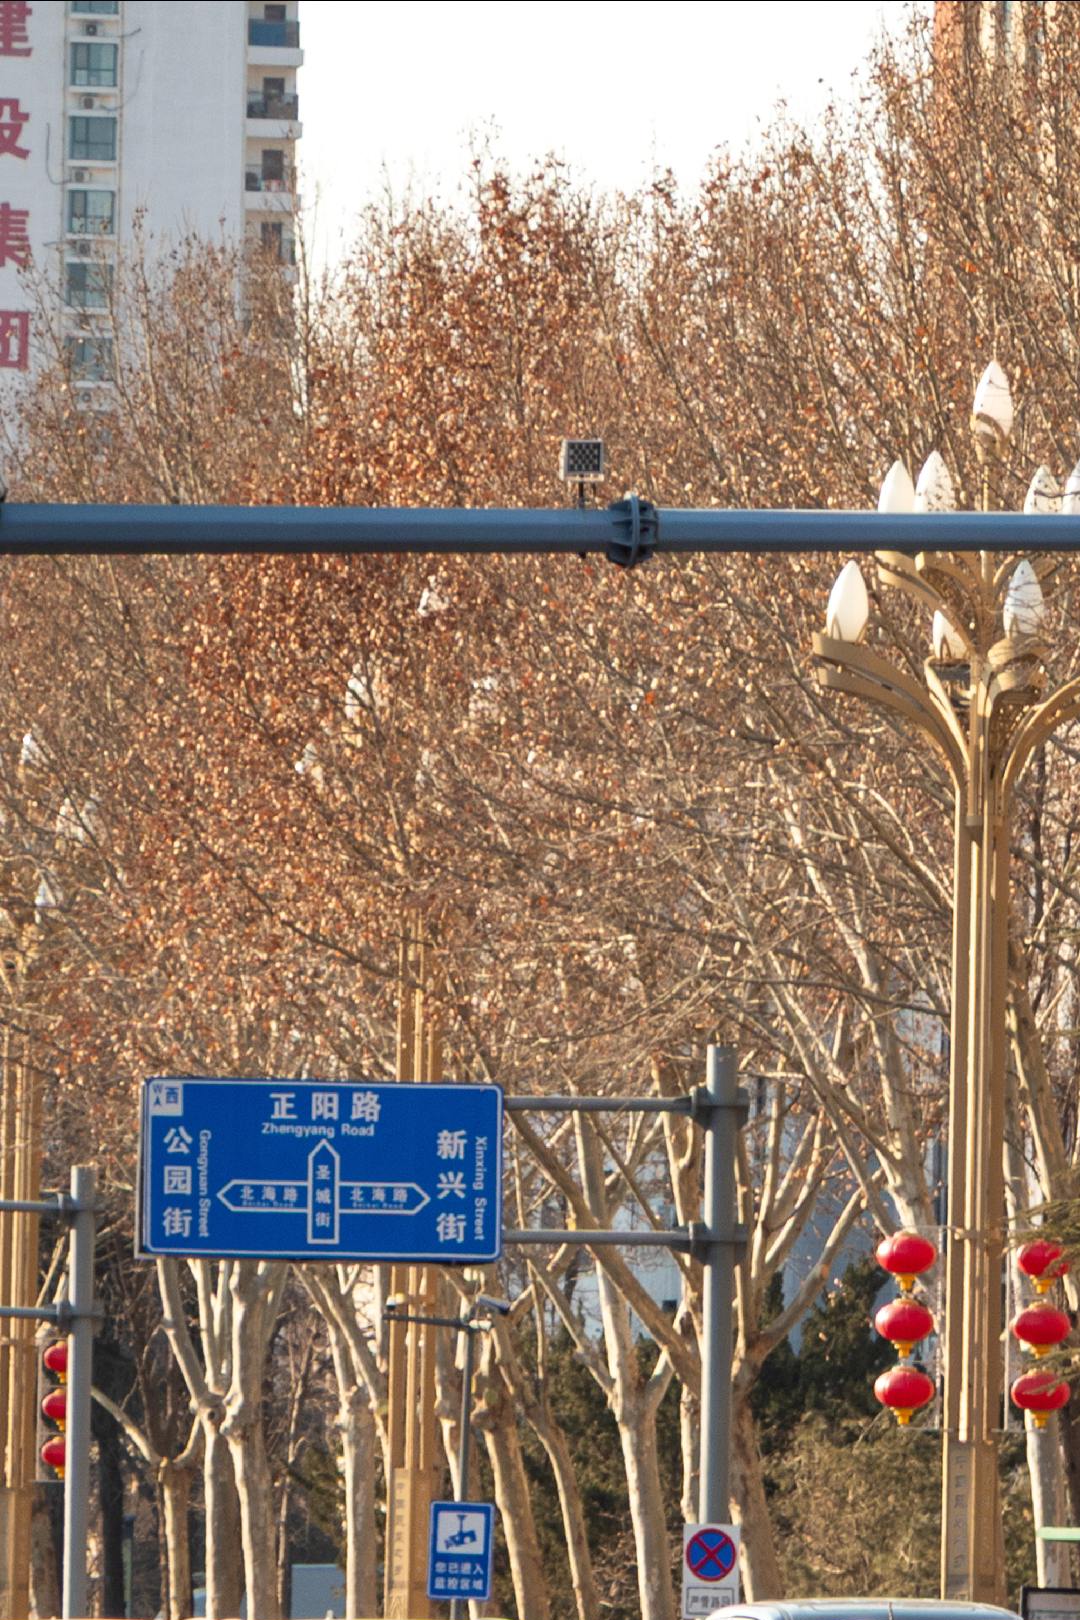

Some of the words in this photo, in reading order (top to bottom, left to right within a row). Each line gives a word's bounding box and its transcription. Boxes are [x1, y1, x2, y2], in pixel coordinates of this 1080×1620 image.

[165, 1087, 179, 1104] 西
[269, 1091, 382, 1122] 正阳路
[261, 1122, 335, 1138] Zhengyang
[341, 1123, 375, 1136] Road
[163, 1126, 193, 1237] 公园街
[197, 1129, 212, 1196] Gongyuan
[472, 1136, 488, 1190] Xinxing
[240, 1185, 298, 1203] 北海路
[349, 1187, 408, 1203] 北海路
[436, 1129, 468, 1243] 新兴街
[198, 1198, 212, 1238] Street
[474, 1197, 488, 1241] Street
